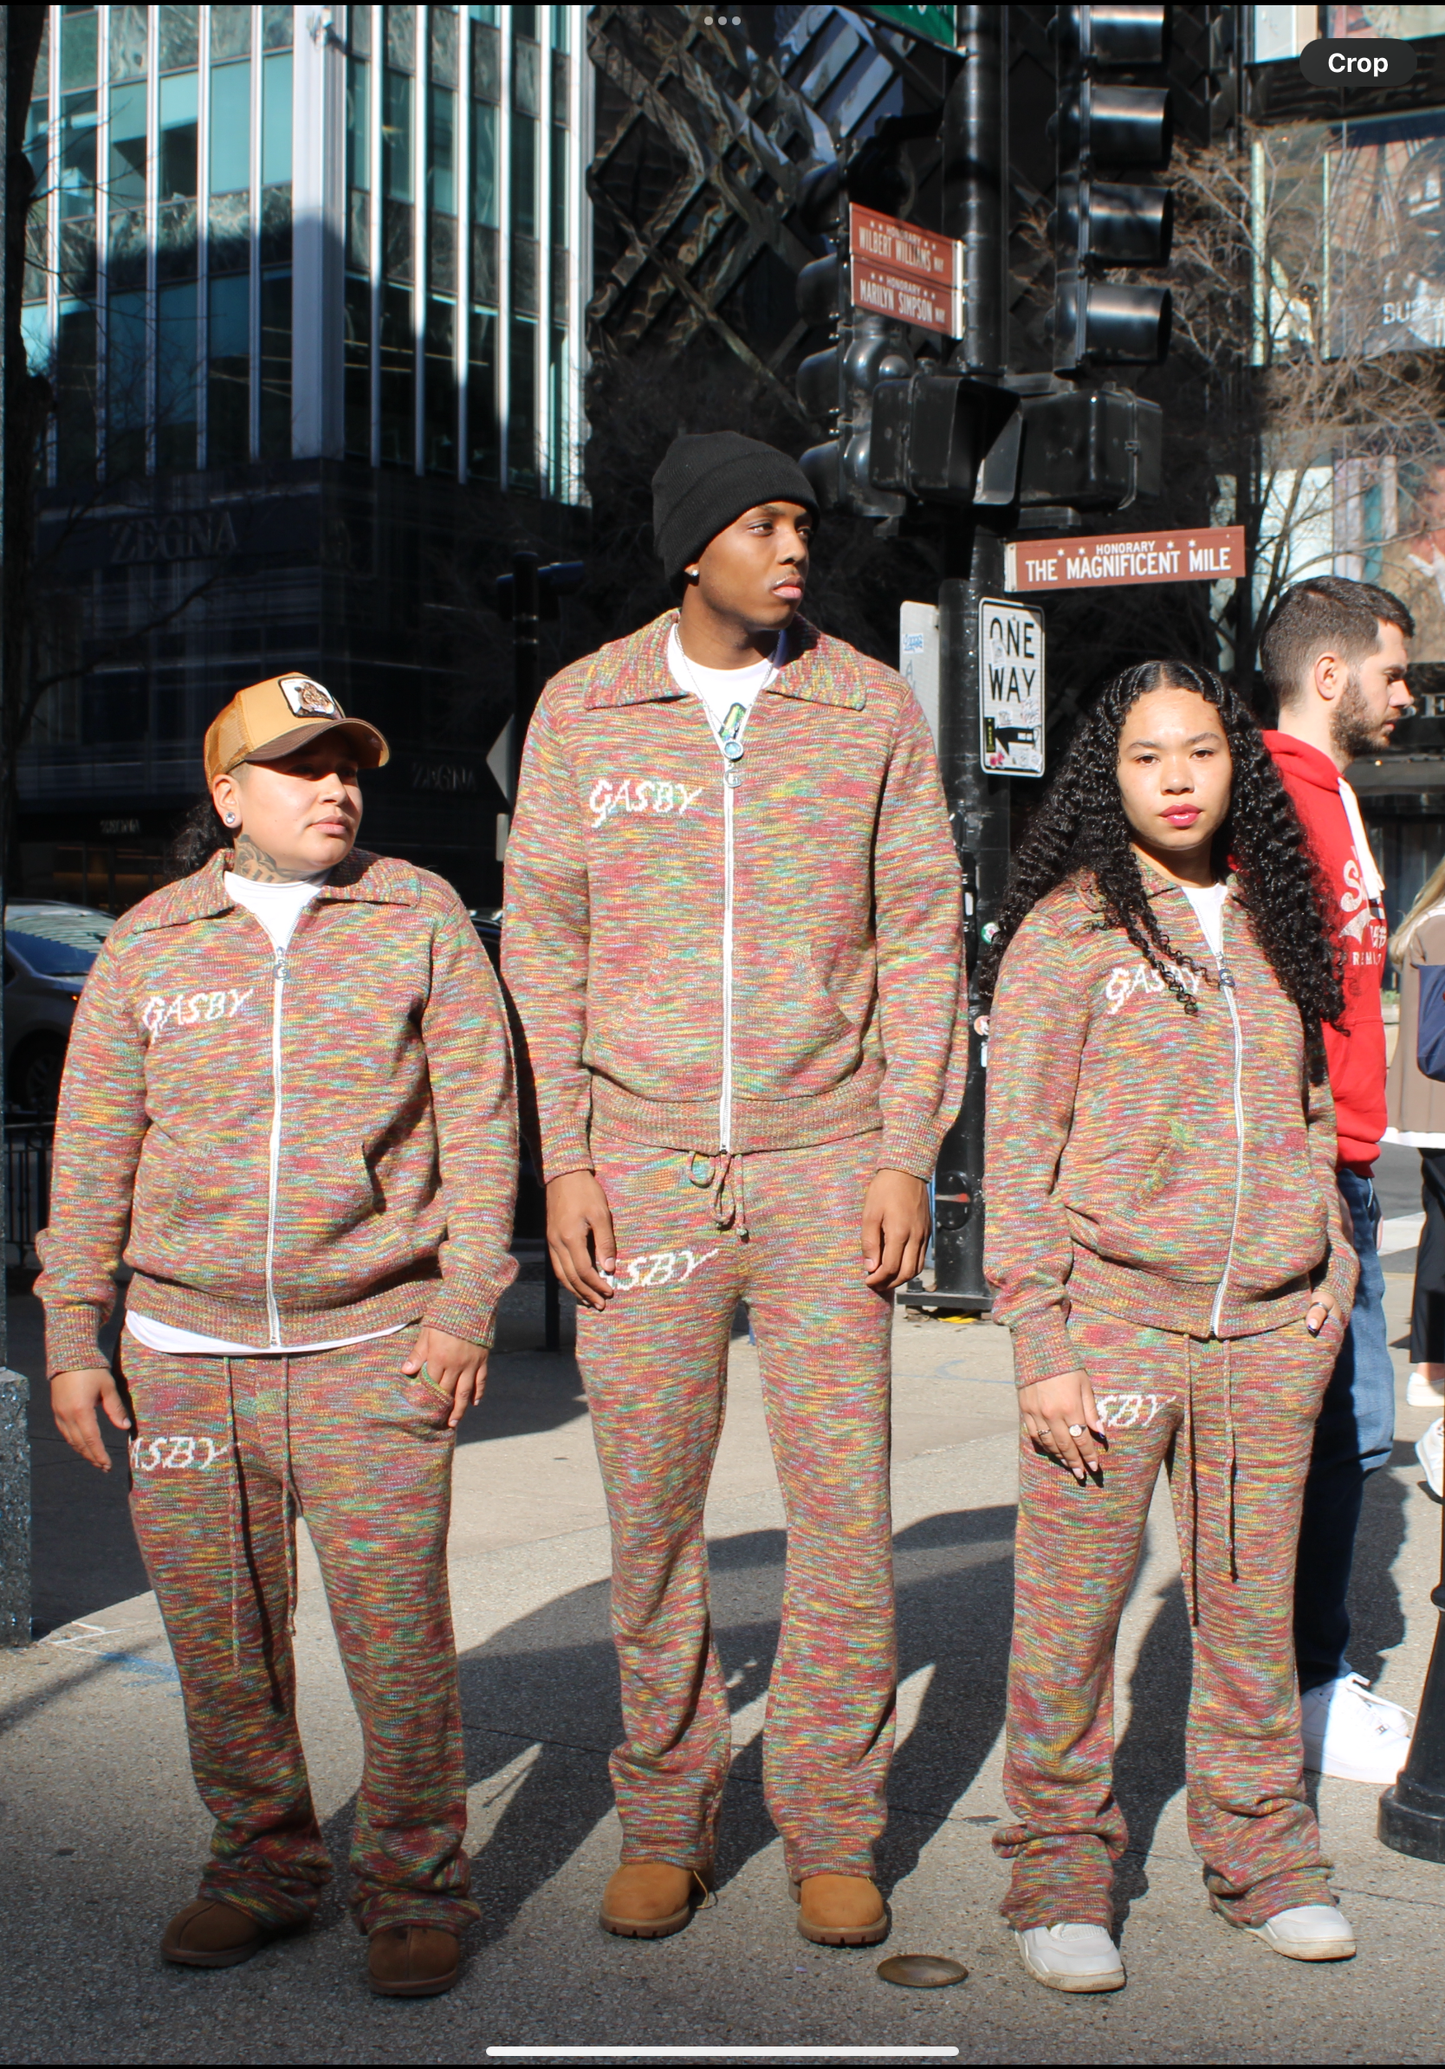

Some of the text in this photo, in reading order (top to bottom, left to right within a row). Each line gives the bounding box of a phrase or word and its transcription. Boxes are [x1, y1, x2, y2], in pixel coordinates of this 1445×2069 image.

[859, 226, 892, 258] WILBERT
[895, 239, 932, 272] WILLIAMS
[860, 278, 895, 311] MARILYN
[898, 291, 933, 323] SIMPSON
[109, 511, 240, 564] ZEGNA
[1096, 540, 1156, 555] HONORARY
[1025, 547, 1232, 582] THE MAGNIFICENT MILE
[990, 618, 1035, 659] ONE
[989, 664, 1036, 703] WAY
[589, 779, 703, 829] GASBY
[142, 988, 254, 1044] GASBY
[1096, 1394, 1176, 1427] SBY
